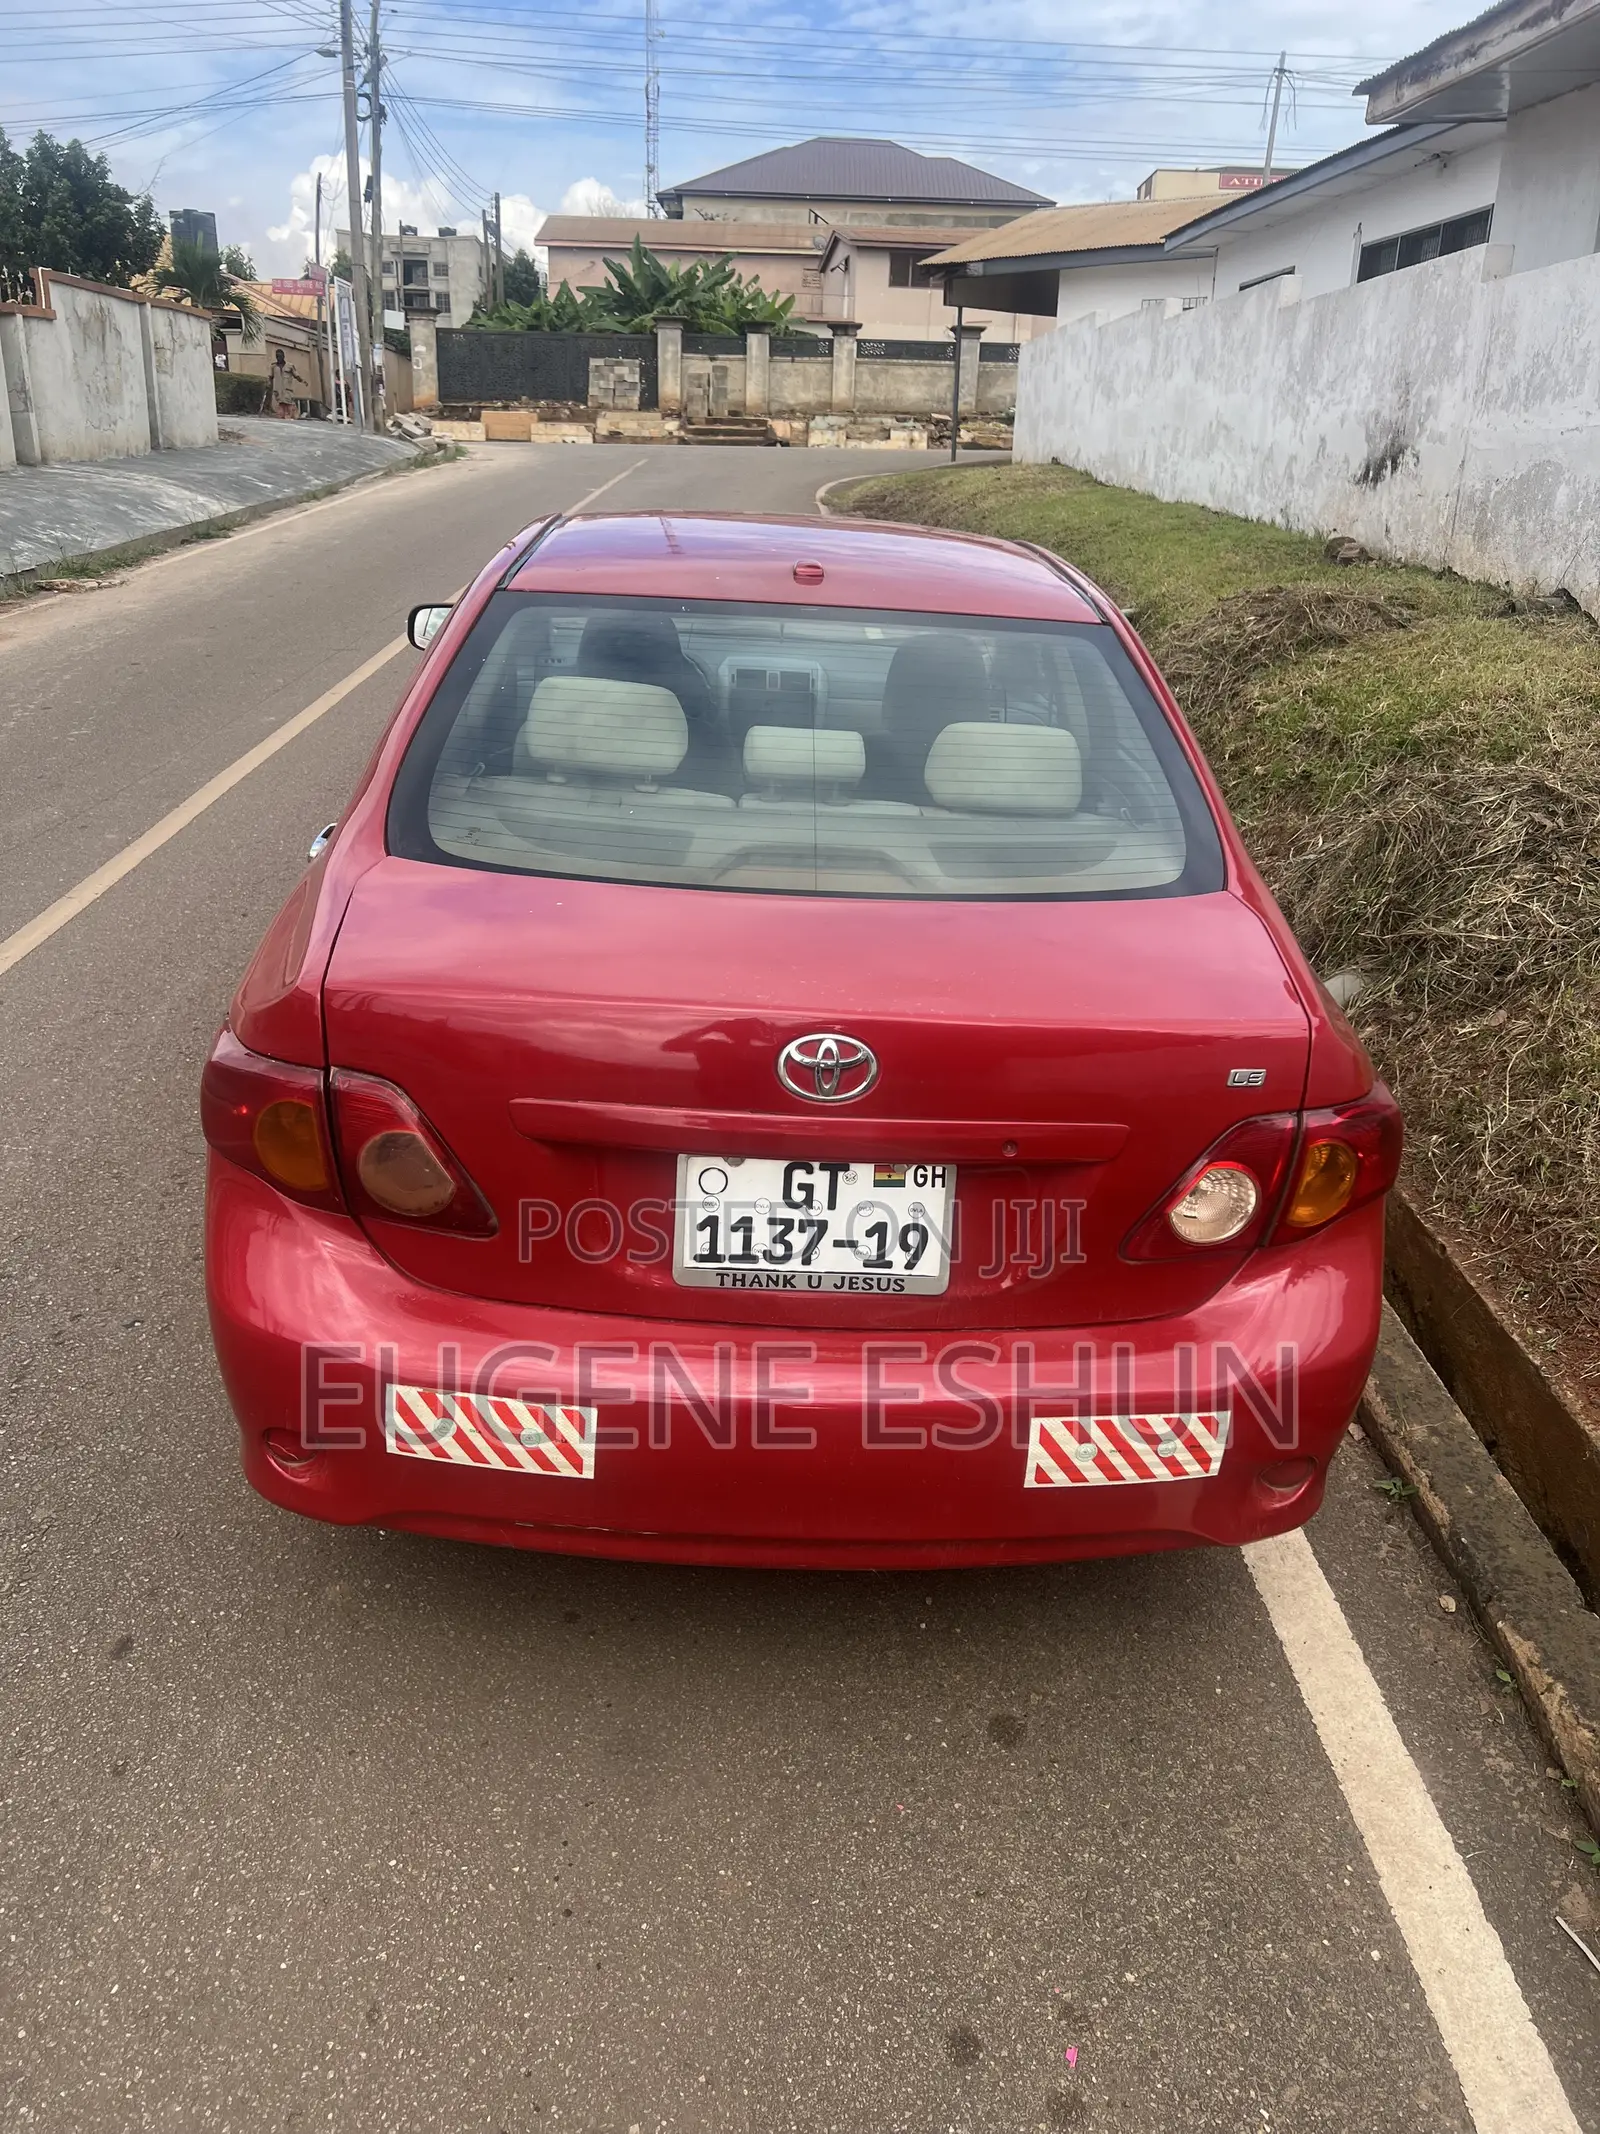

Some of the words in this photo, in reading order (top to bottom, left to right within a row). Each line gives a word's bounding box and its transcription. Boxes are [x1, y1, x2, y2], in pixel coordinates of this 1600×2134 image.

[1232, 1071, 1265, 1086] LE
[782, 1161, 850, 1211] GT
[913, 1164, 946, 1188] GH
[693, 1215, 929, 1270] 1137-19
[716, 1273, 797, 1289] THANK
[807, 1275, 823, 1289] U
[833, 1276, 906, 1292] JESUS
